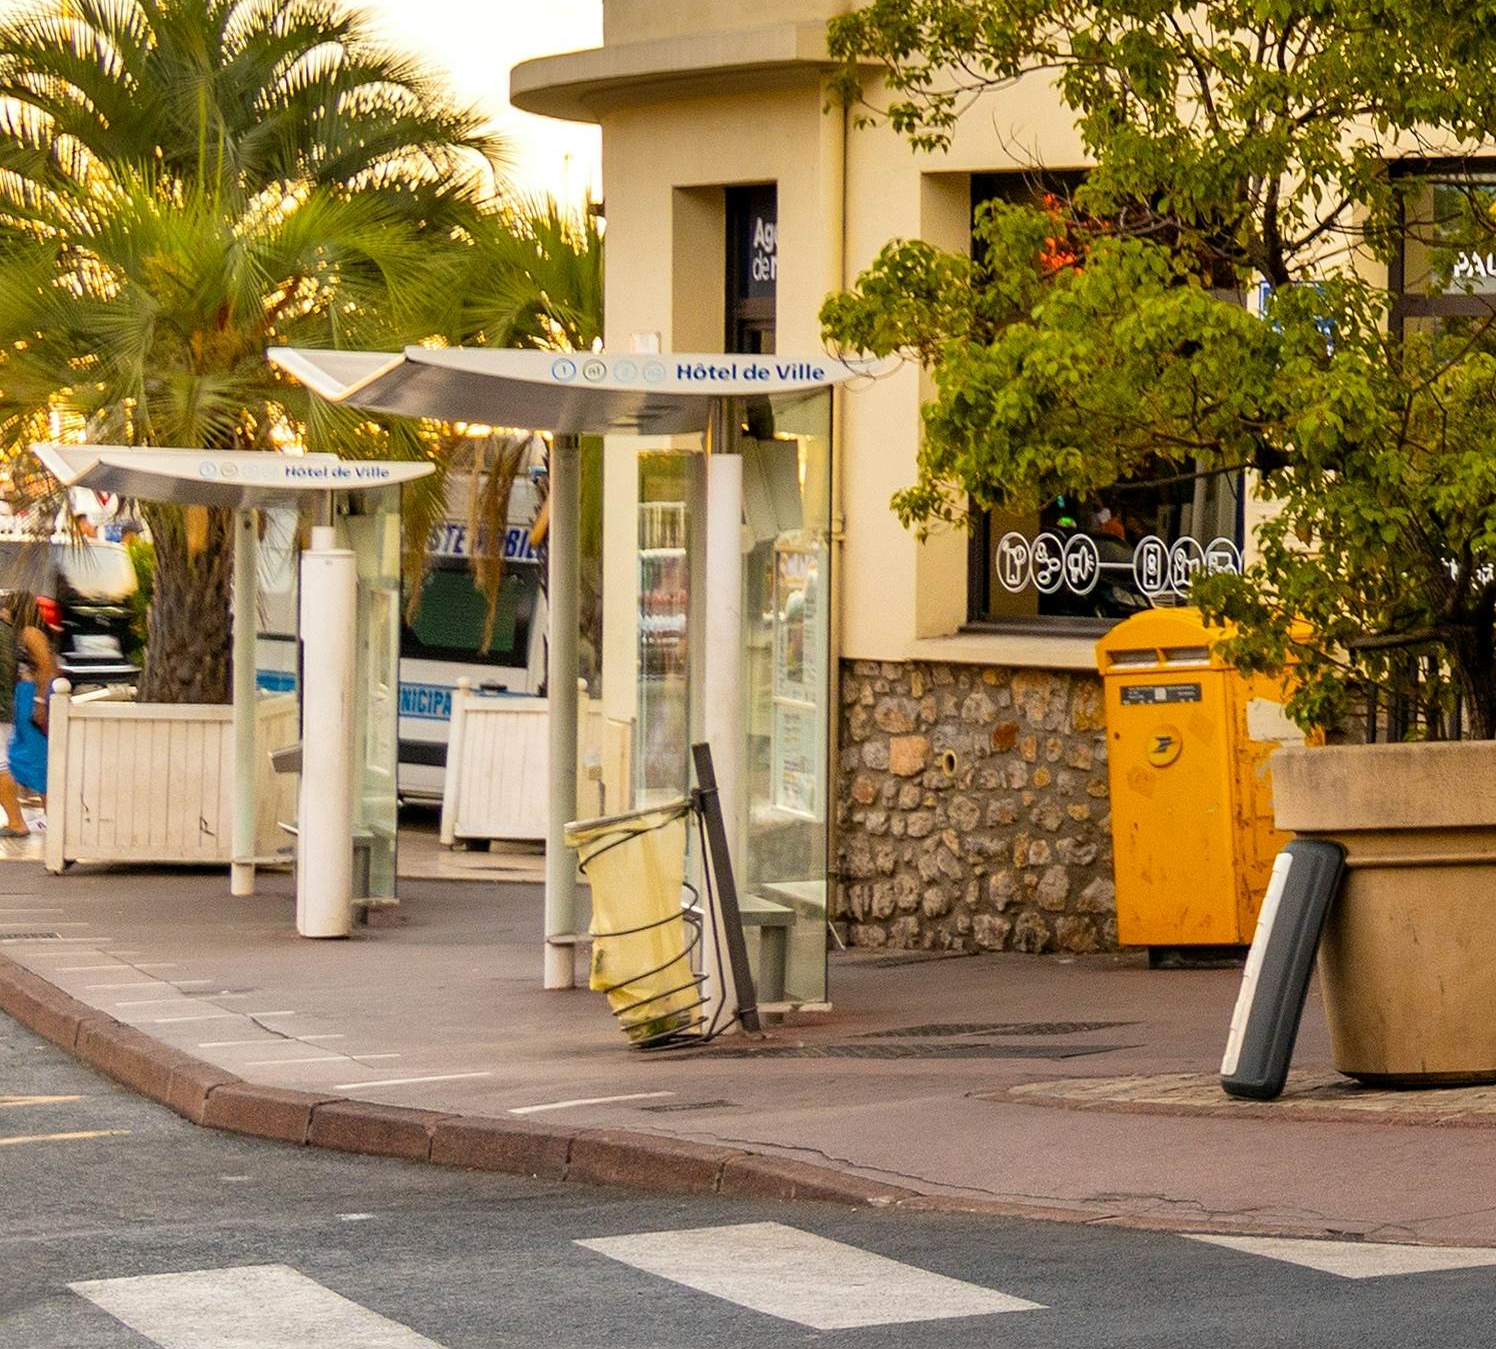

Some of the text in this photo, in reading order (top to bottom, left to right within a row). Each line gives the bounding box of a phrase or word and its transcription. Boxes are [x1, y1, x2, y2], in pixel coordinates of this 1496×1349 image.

[676, 363, 738, 381] Hôtel
[743, 364, 770, 381] de
[775, 363, 826, 381] Ville
[285, 466, 328, 478] Hôtel
[331, 466, 351, 478] de
[355, 466, 390, 478] Ville
[401, 685, 452, 716] NICIPA
